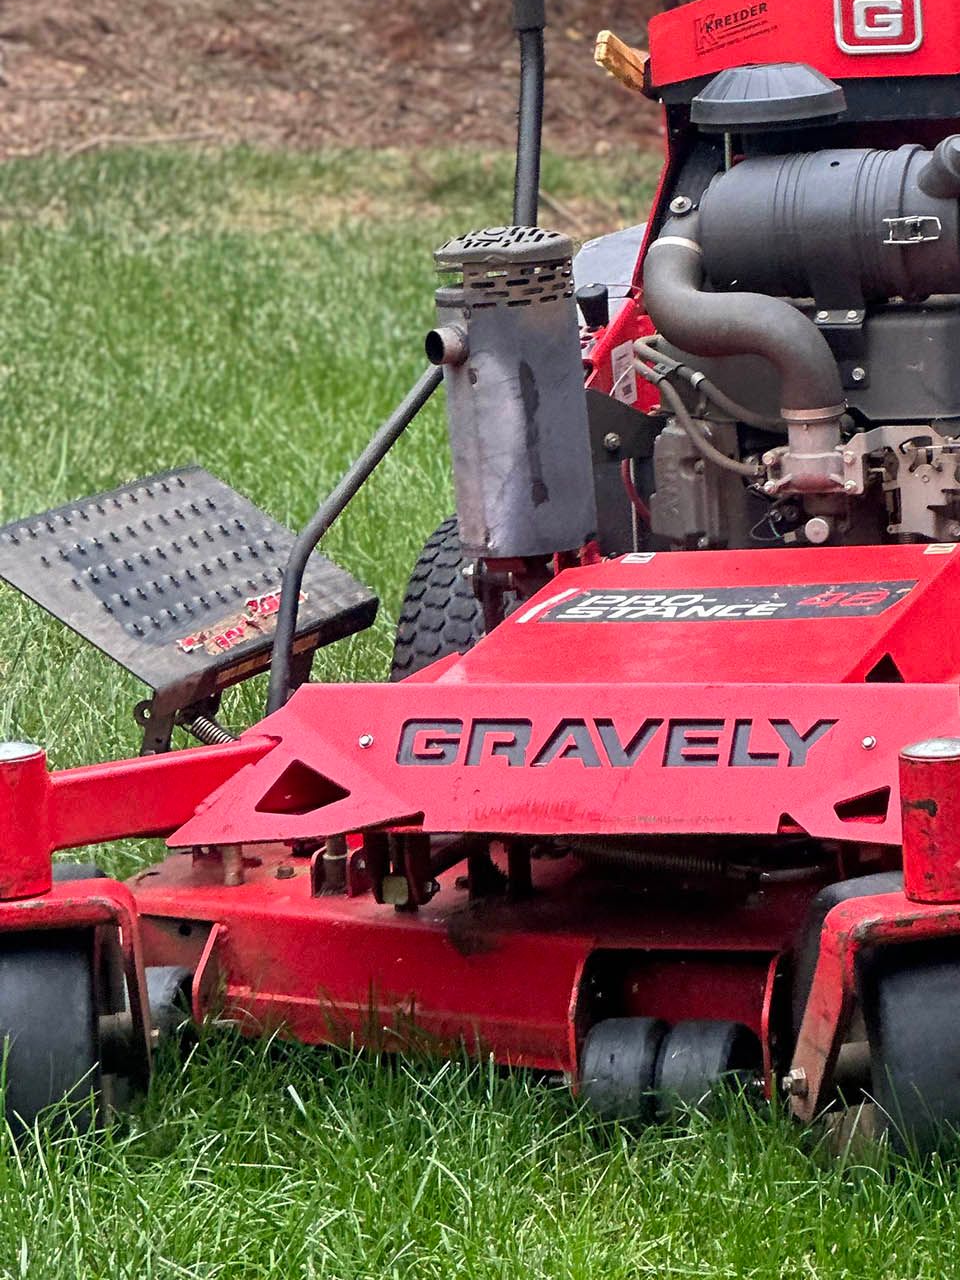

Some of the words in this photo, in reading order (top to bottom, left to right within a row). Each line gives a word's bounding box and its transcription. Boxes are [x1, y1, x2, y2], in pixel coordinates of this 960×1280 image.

[705, 2, 768, 33] KREIDER
[556, 603, 787, 619] STANCE
[796, 591, 890, 607] 48
[577, 594, 717, 607] PRO-
[396, 718, 840, 767] GRAVELY
